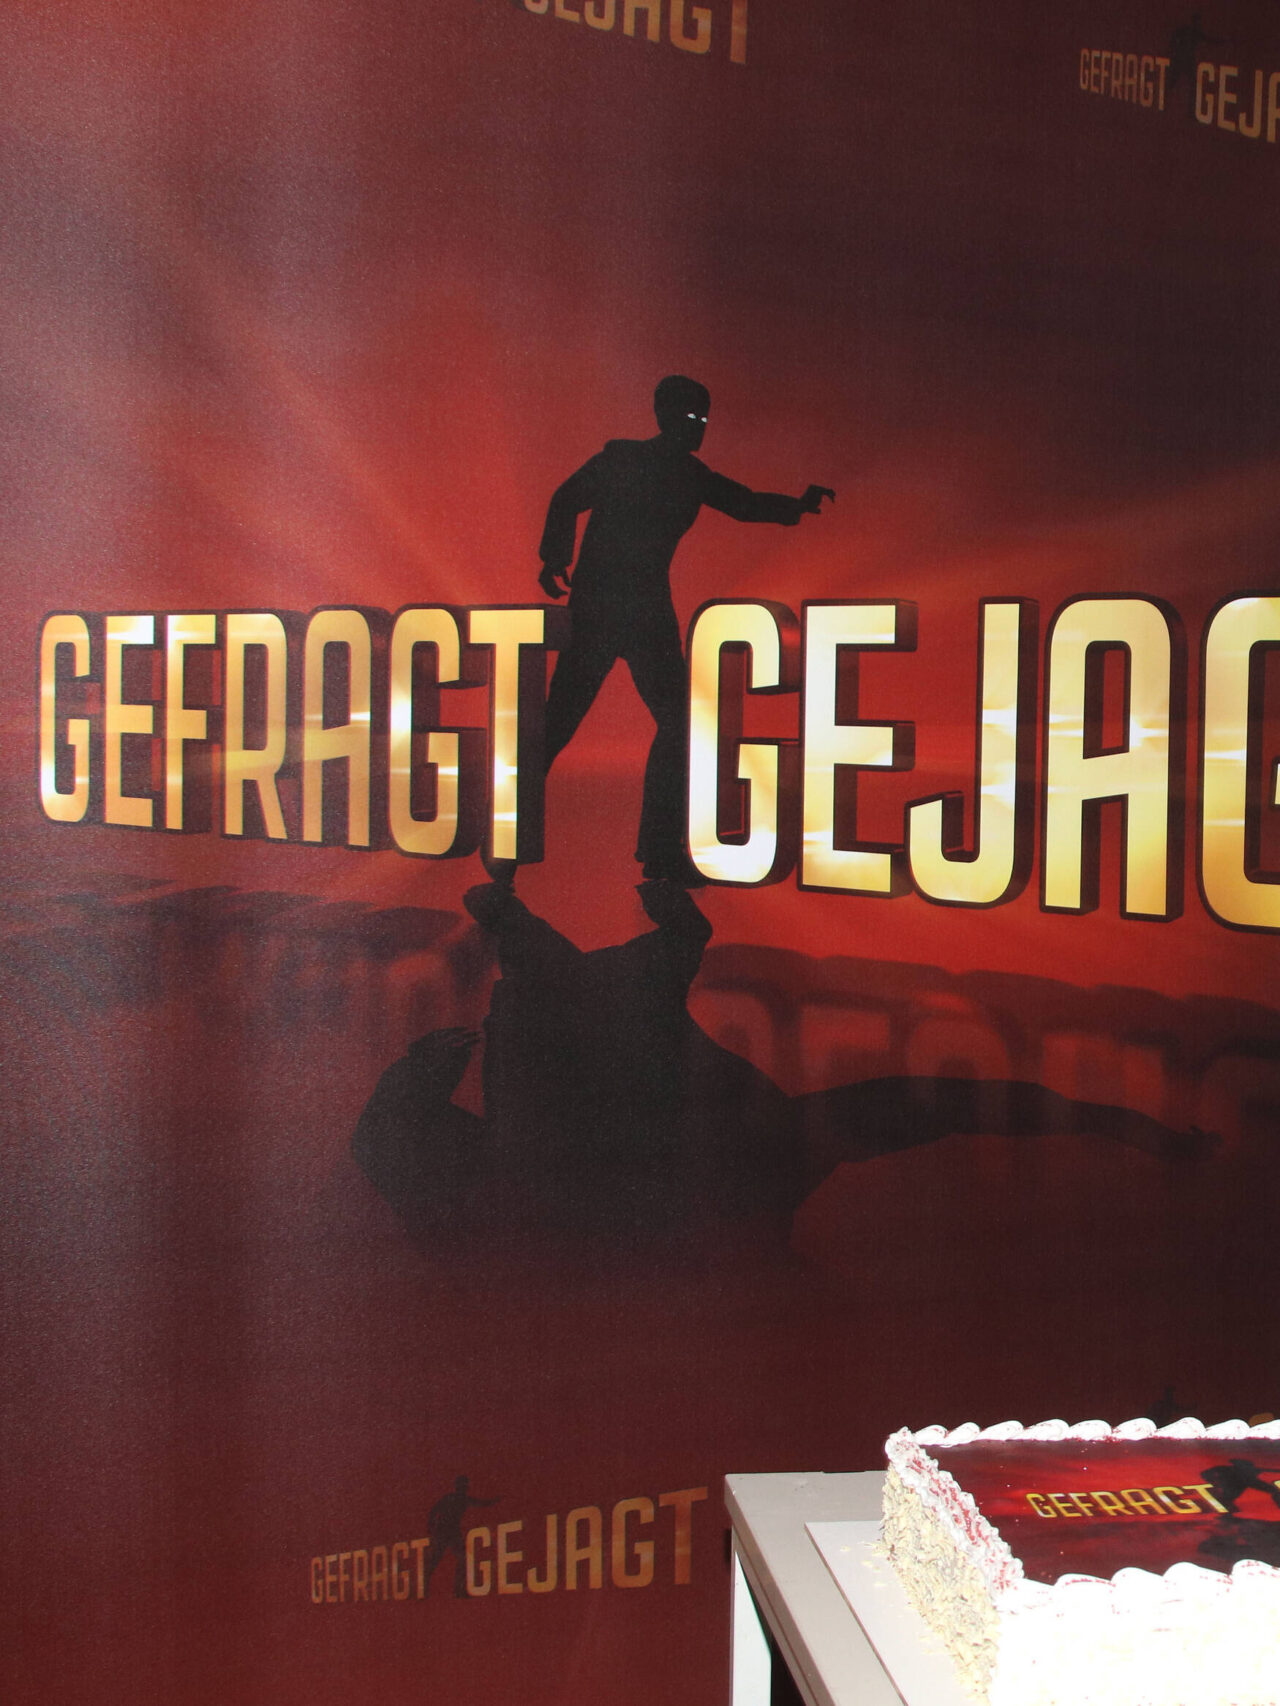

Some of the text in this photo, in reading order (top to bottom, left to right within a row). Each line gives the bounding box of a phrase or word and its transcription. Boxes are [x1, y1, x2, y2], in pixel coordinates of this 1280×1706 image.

[522, 0, 748, 64] AGT
[1079, 49, 1170, 111] GEFRAGT
[38, 606, 546, 861] GEFRAGT
[1026, 1483, 1230, 1518] GEFRAGT
[310, 1487, 708, 1604] GEFRAGT GEJAGT
